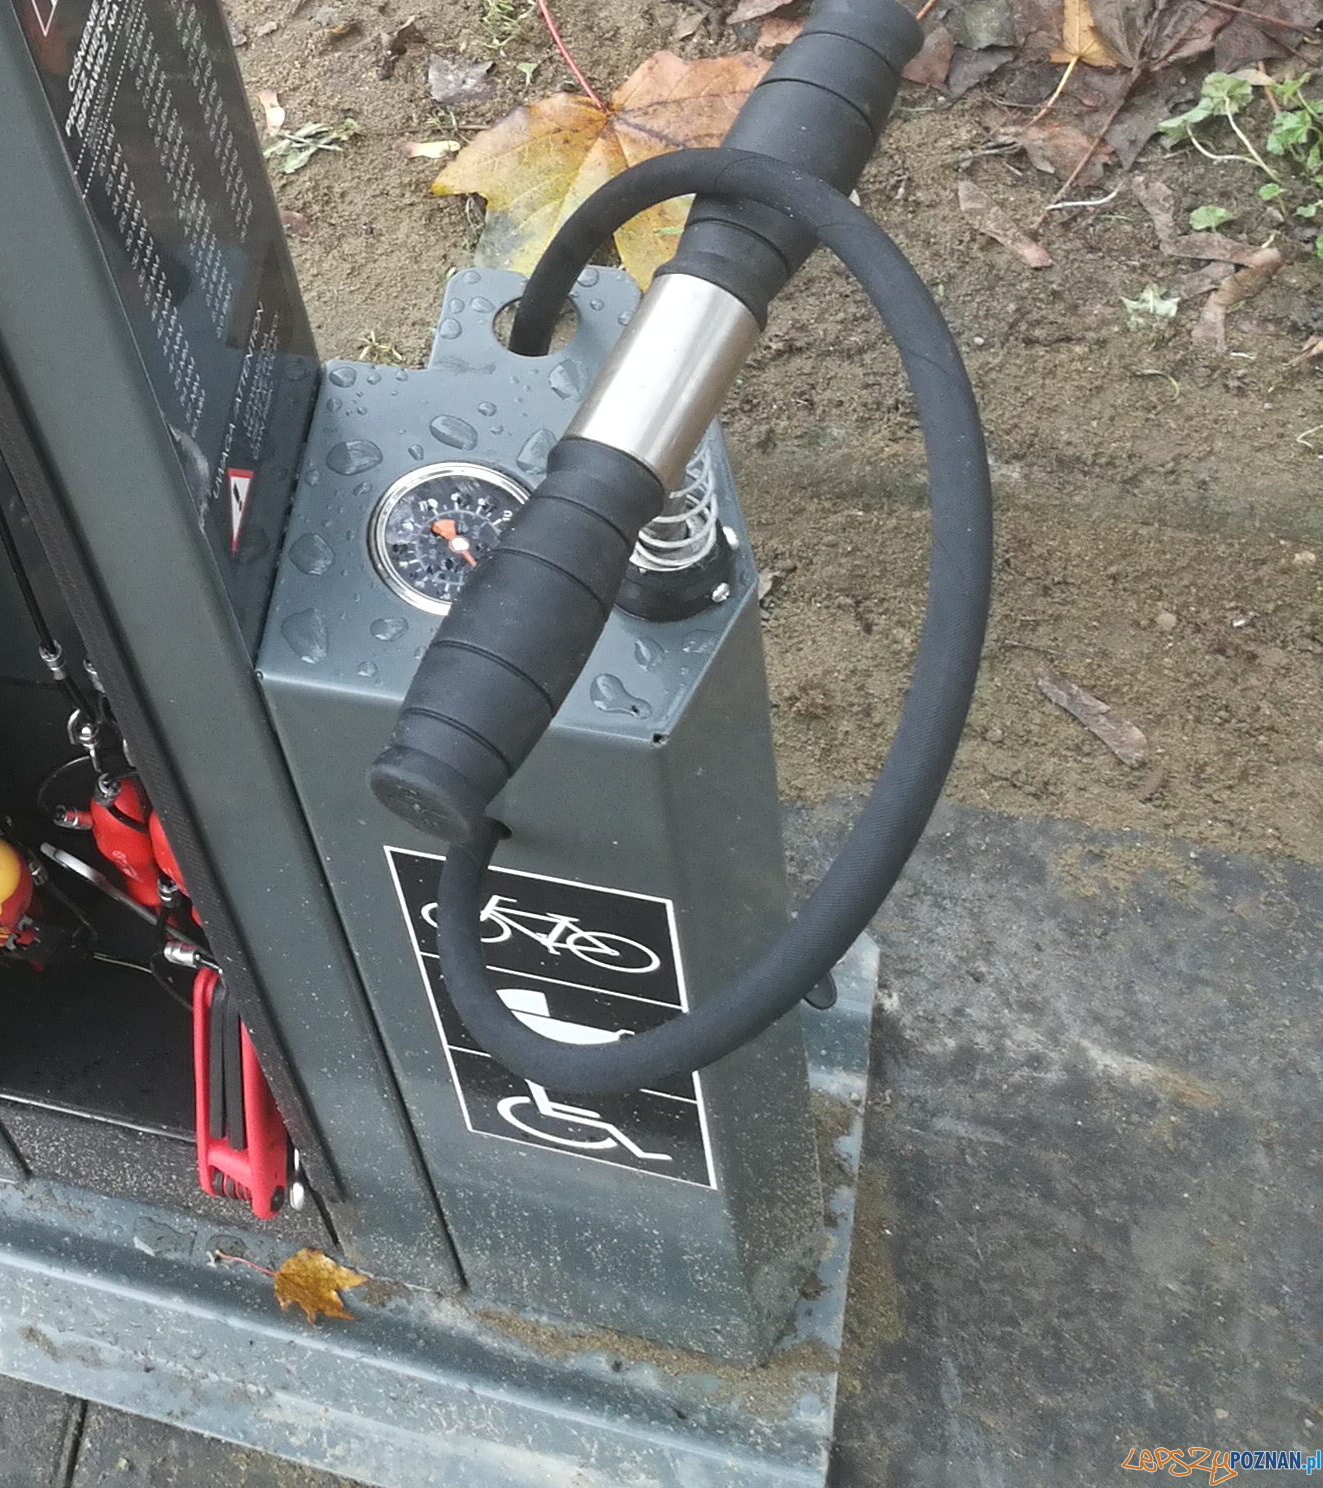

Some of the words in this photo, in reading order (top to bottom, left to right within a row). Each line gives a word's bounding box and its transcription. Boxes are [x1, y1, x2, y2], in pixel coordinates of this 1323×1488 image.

[103, 123, 115, 154] MM
[135, 12, 148, 46] BAR
[107, 3, 118, 31] NA
[64, 71, 87, 136] PRZEZ
[110, 143, 122, 174] MM
[141, 31, 154, 65] BAR
[117, 162, 128, 193] MM
[148, 52, 160, 86] BAR
[123, 180, 135, 211] MM
[154, 70, 166, 104] BAR
[130, 199, 141, 230] MM
[160, 89, 172, 123] BAR
[136, 217, 147, 248] MM
[166, 108, 177, 141] BAR
[143, 236, 153, 265] MM
[172, 126, 184, 160] BAR
[149, 254, 160, 284] MM
[178, 144, 189, 177] BAR
[155, 271, 166, 300] MM
[184, 163, 195, 196] BAR
[161, 289, 172, 318] MM
[189, 181, 200, 214] BAR
[167, 306, 178, 334] MM
[195, 198, 206, 231] BAR
[173, 324, 183, 353] MM
[200, 215, 211, 248] BAR
[179, 340, 189, 369] MM
[205, 233, 217, 265] BAR
[184, 356, 195, 385] MM
[211, 249, 222, 282] BAR
[190, 373, 200, 401] MM
[216, 266, 227, 298] BAR
[195, 388, 205, 417] MM
[221, 282, 232, 314] BAR
[212, 423, 235, 498] UWAGA
